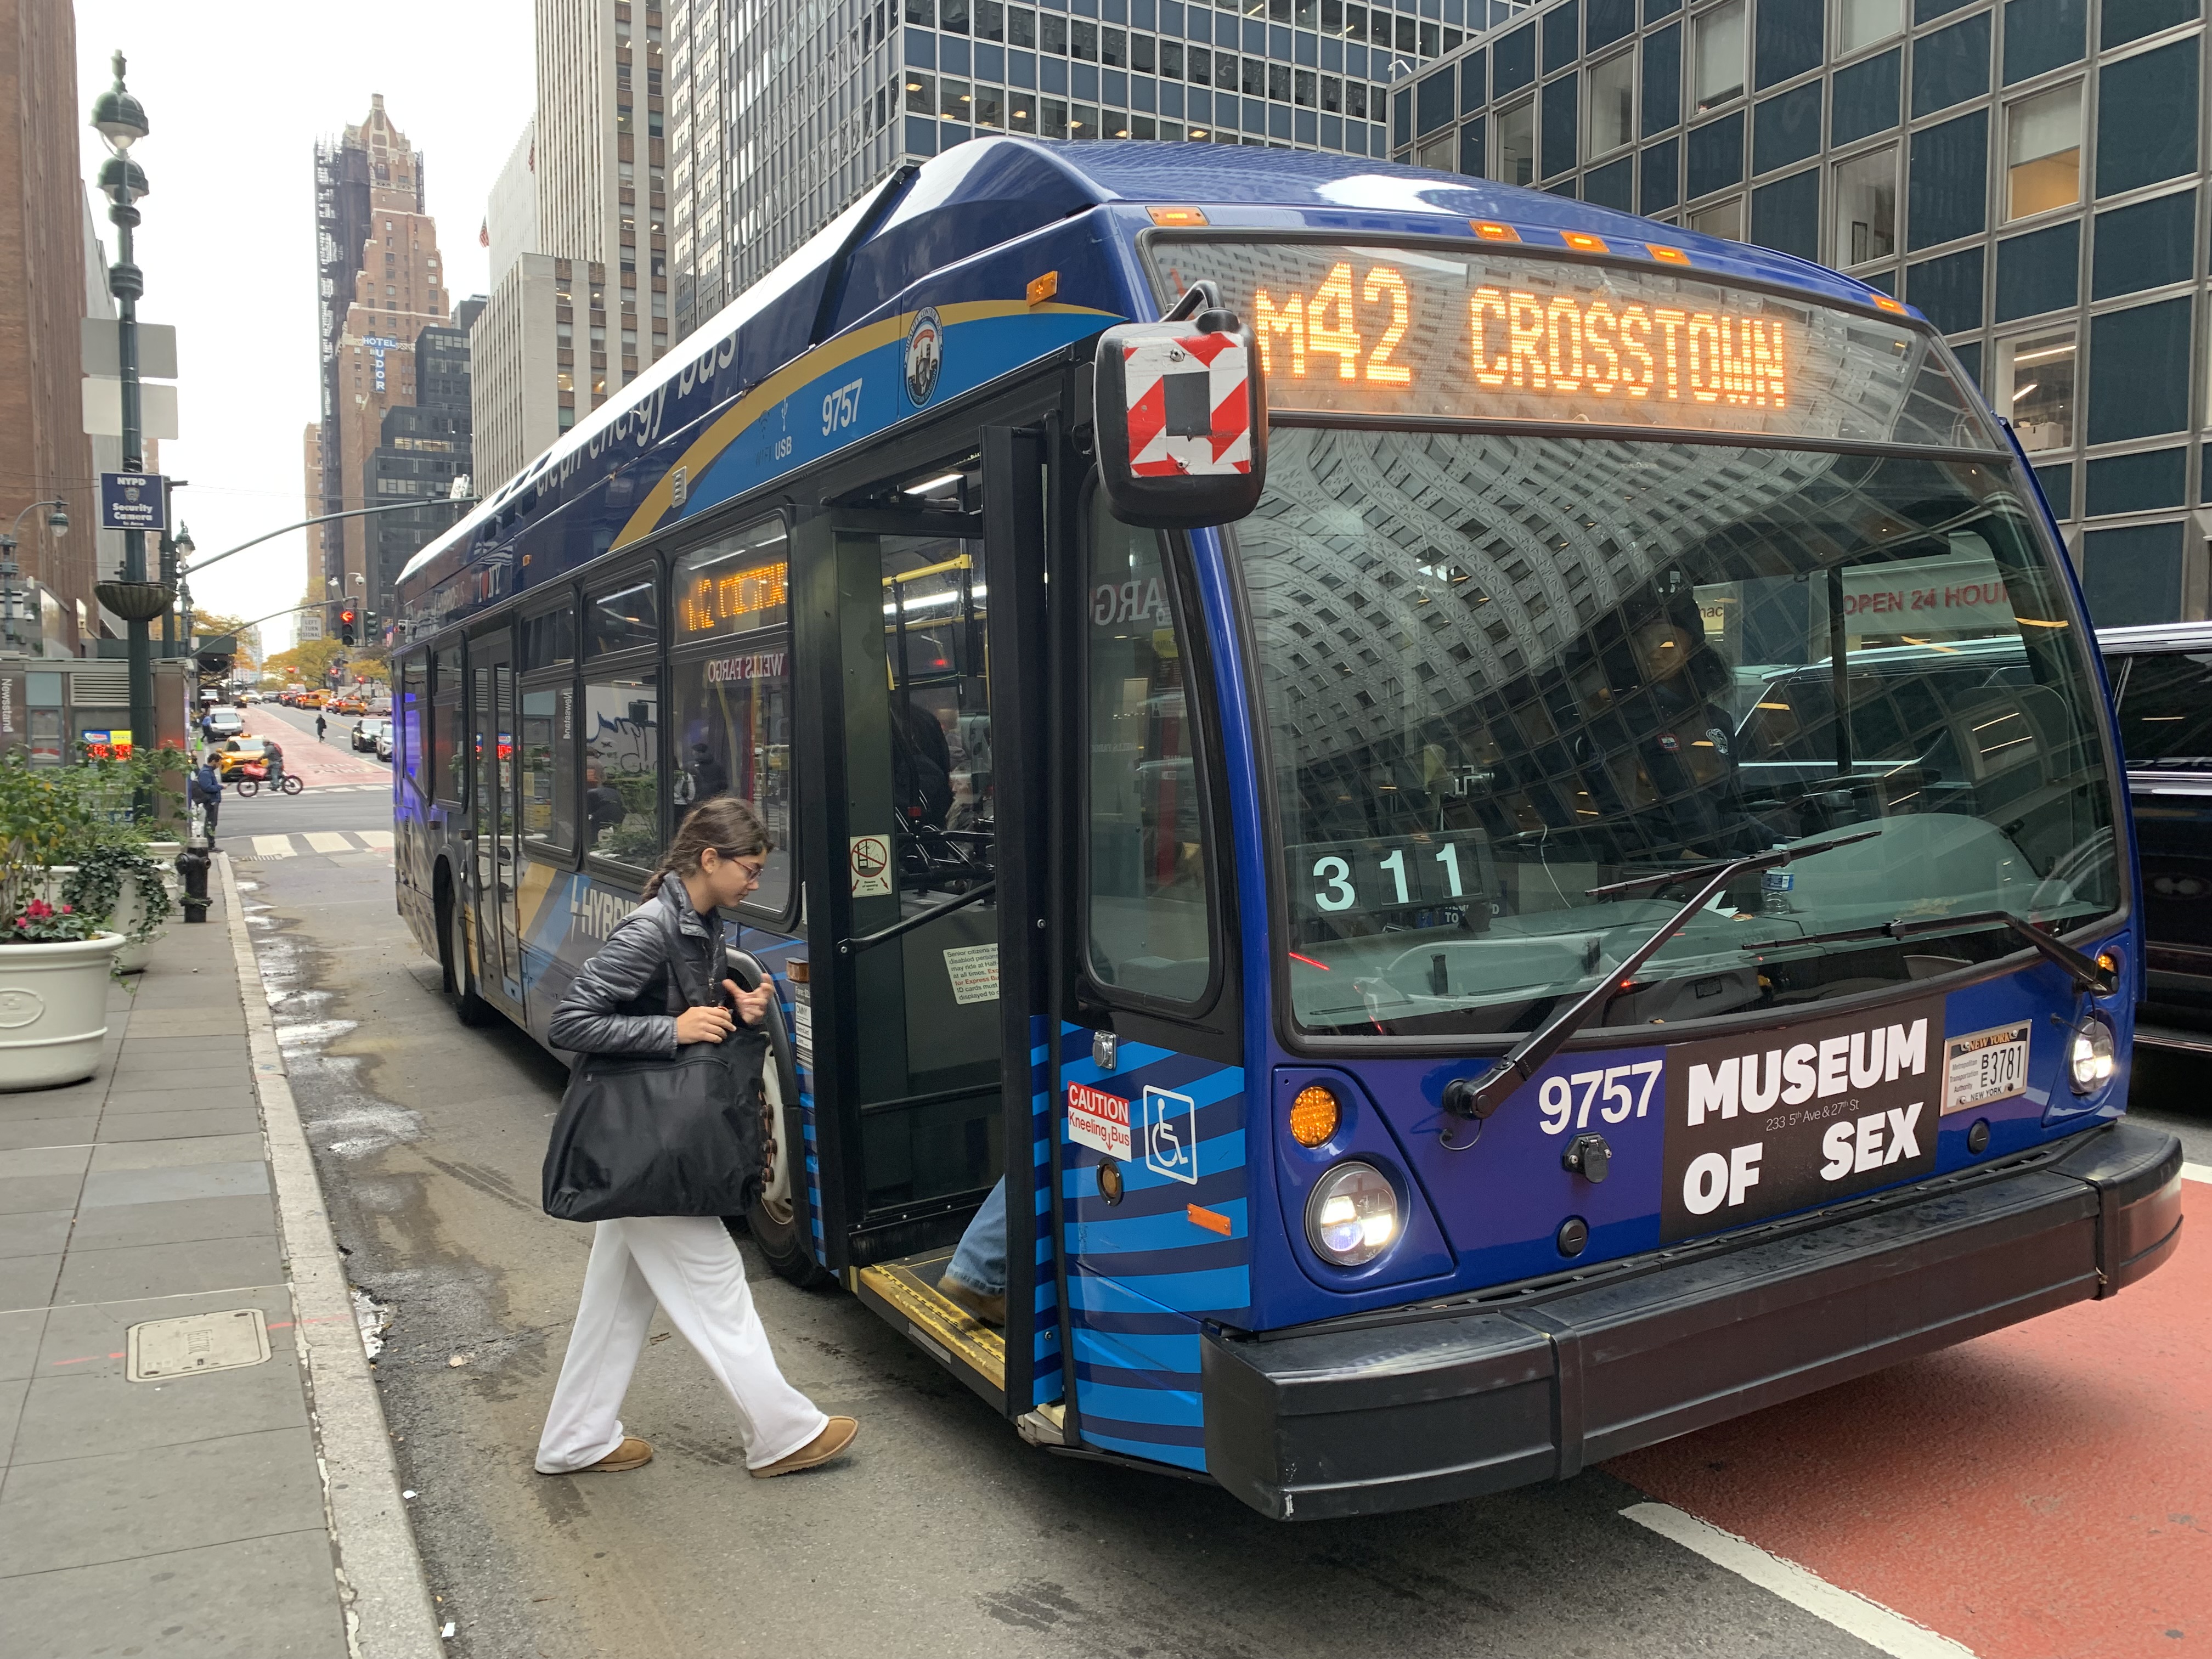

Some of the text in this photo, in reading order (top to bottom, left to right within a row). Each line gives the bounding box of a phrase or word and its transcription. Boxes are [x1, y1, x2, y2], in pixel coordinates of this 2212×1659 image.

[921, 309, 937, 321] CONTROL
[363, 337, 396, 347] HOTEL
[1254, 262, 1786, 408] M42 CROSSTOWN
[822, 377, 862, 437] 9757
[775, 436, 792, 460] USB
[116, 477, 146, 486] NYPD
[112, 503, 153, 514] Security
[114, 511, 153, 521] Camera
[1844, 590, 1903, 614] OPEN
[1911, 588, 1937, 611] 24
[1, 679, 14, 732] Newsstand
[964, 977, 990, 985] Express
[959, 991, 988, 1000] displayed
[797, 1005, 808, 1017] OMNY
[1970, 1032, 2010, 1051] NEW YORK
[1687, 1018, 1928, 1127] MUSEUM
[1952, 1059, 1978, 1071] Metropolitan
[1990, 1045, 2021, 1085] 3781
[1950, 1070, 1979, 1083] Transportation
[1538, 1060, 1663, 1135] 9757
[1954, 1083, 1973, 1093] Authority
[1971, 1086, 2002, 1102] NEW YORK
[1070, 1085, 1129, 1124] CAUTION
[1766, 1116, 1786, 1131] 233
[1803, 1110, 1820, 1122] Ave
[1822, 1105, 1830, 1118] &
[1849, 1099, 1860, 1111] St
[1069, 1111, 1130, 1147] Kneeling Bus
[1683, 1102, 1923, 1215] OF SEX
